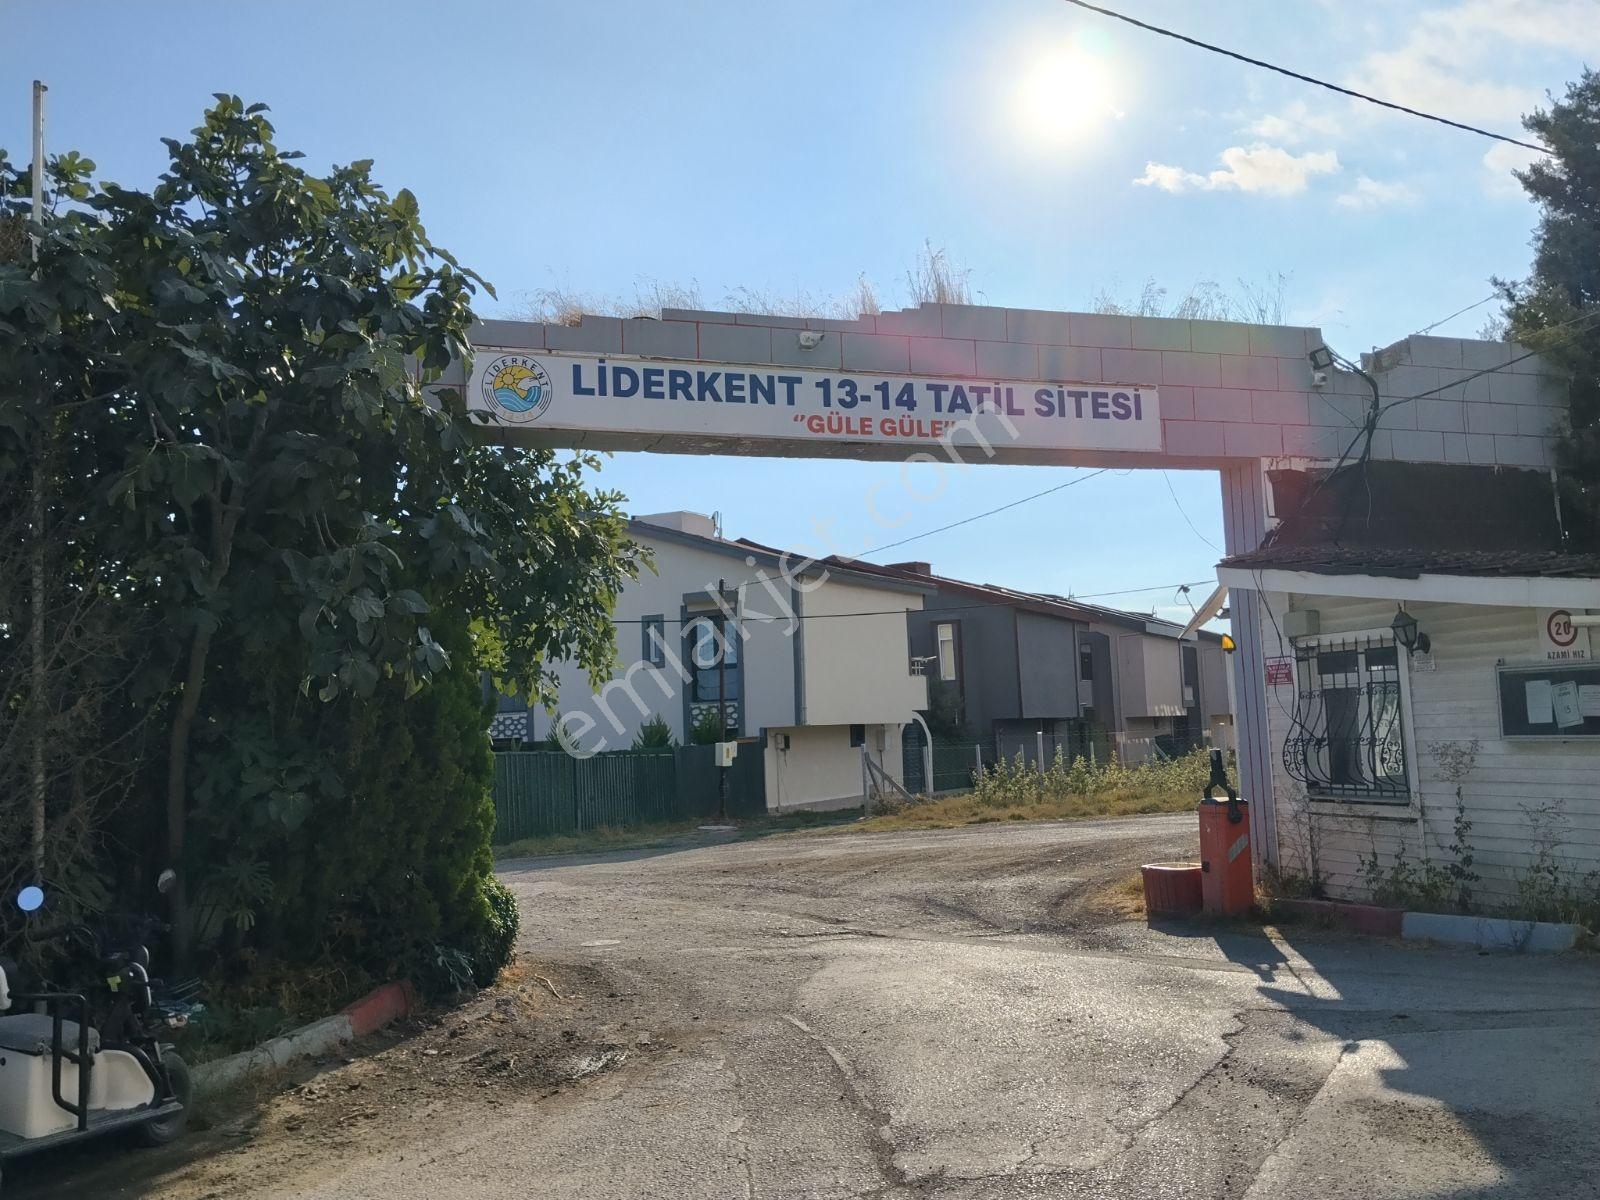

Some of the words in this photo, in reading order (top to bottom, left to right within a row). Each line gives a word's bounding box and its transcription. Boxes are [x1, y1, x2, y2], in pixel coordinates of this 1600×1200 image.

[571, 358, 803, 407] LİDERKENT
[815, 378, 917, 412] 13-14
[926, 382, 1025, 416] TATİL
[1034, 385, 1142, 421] SİTESİ
[1555, 621, 1571, 636] 20
